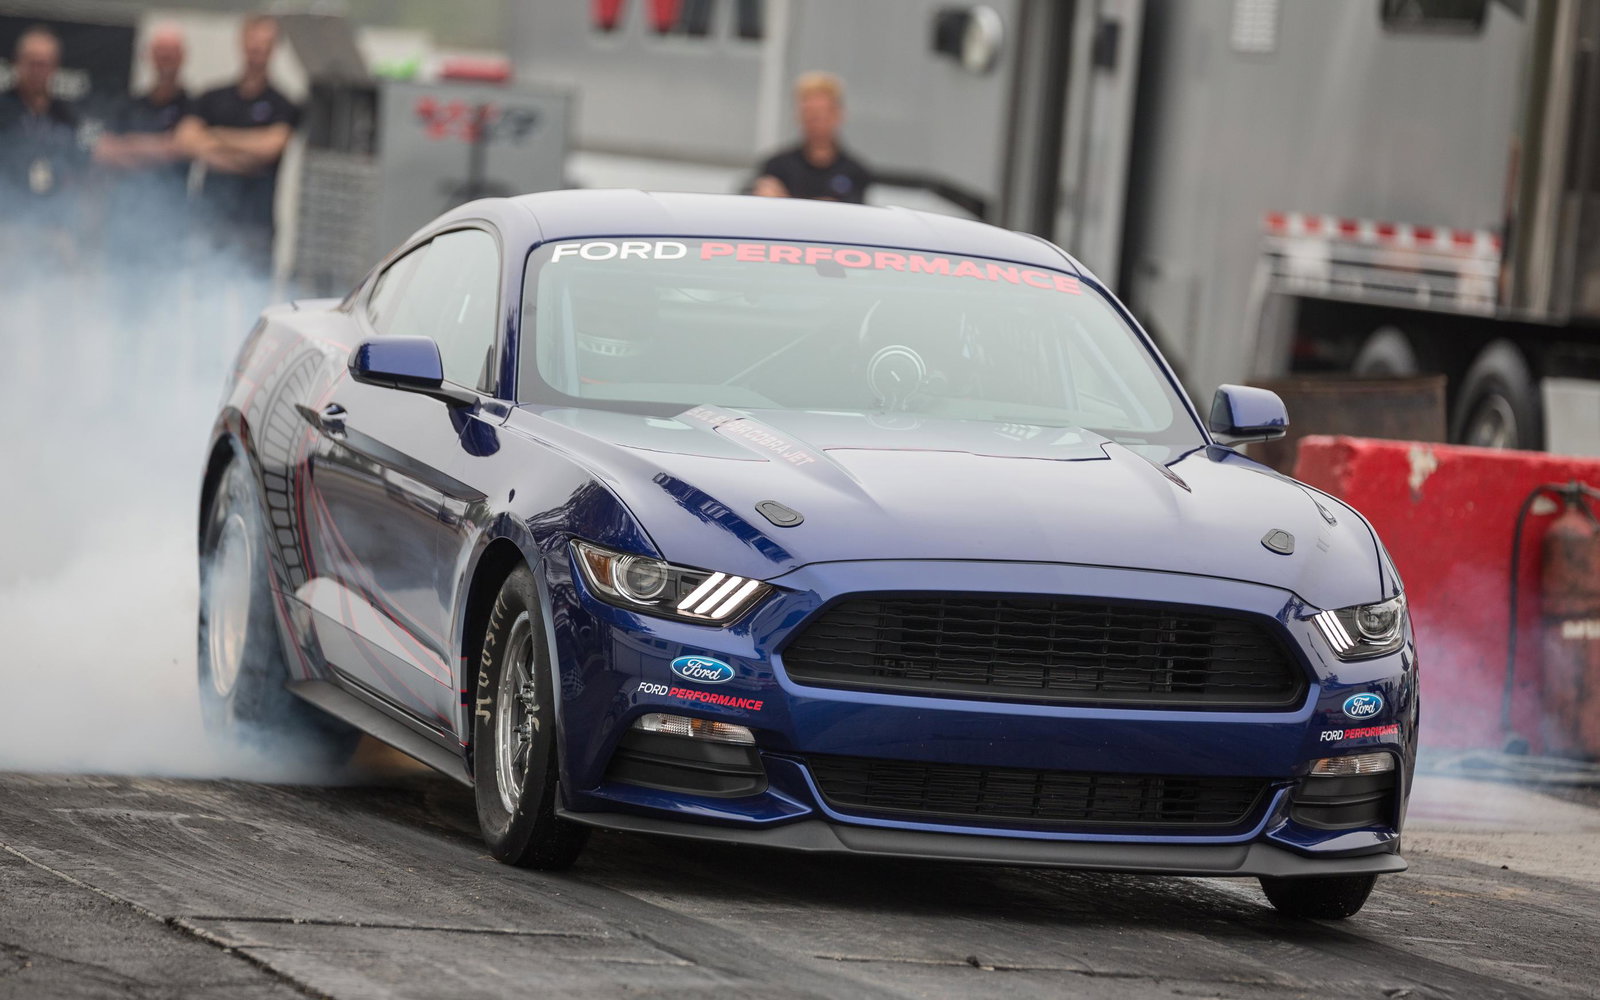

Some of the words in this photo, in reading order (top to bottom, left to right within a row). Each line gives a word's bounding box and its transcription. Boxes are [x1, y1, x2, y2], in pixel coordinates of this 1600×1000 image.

[551, 241, 688, 263] FORD
[700, 242, 1083, 295] PERFORMANCE
[682, 658, 721, 681] Ford
[637, 682, 668, 696] FORD
[668, 687, 763, 711] PERFORMANCE
[1320, 730, 1344, 741] FORD
[1344, 723, 1399, 739] PERFORMANCE
